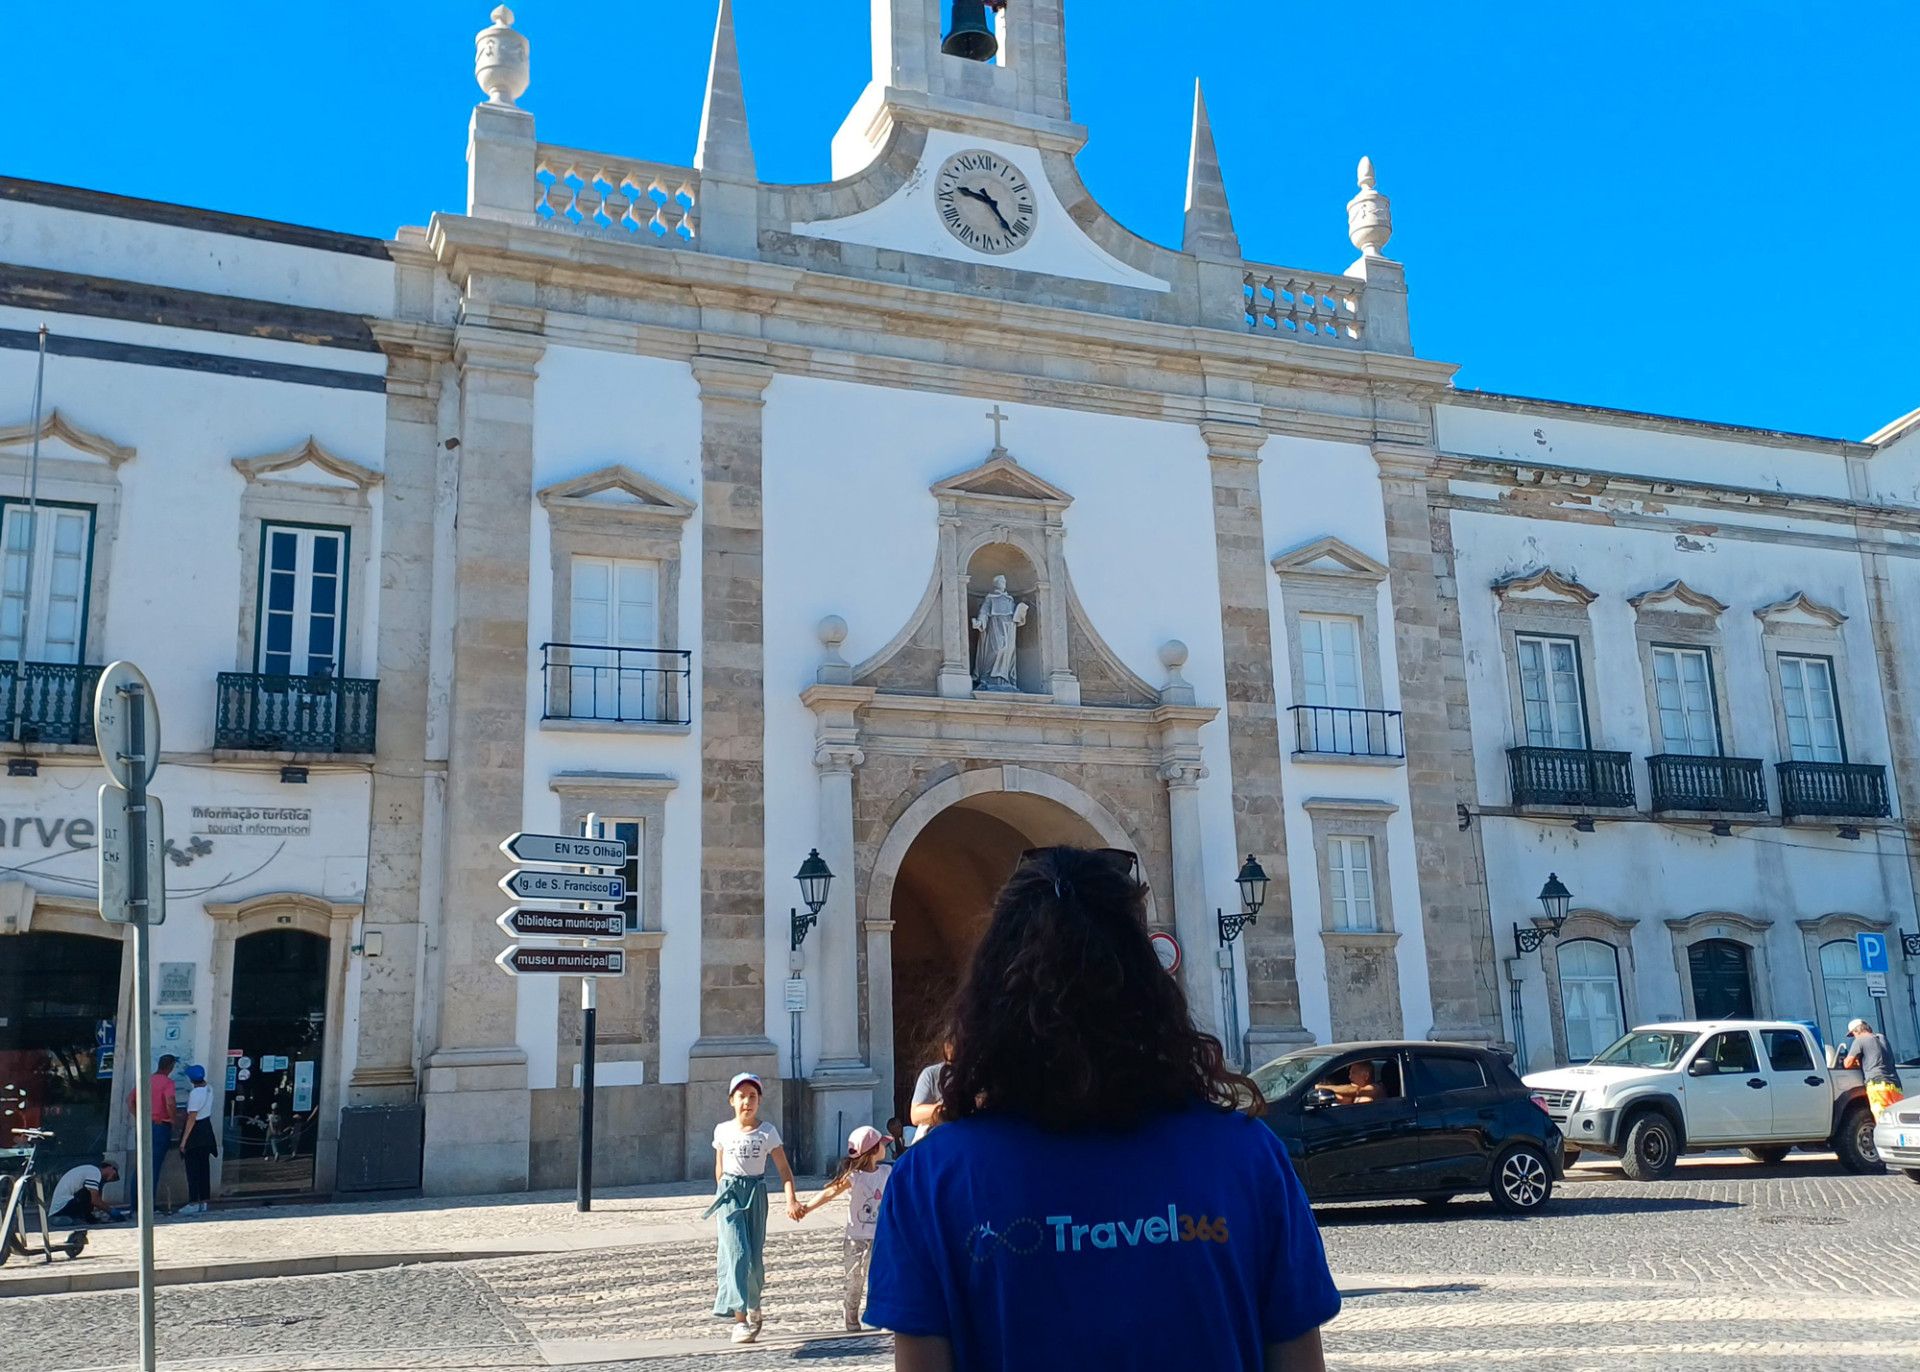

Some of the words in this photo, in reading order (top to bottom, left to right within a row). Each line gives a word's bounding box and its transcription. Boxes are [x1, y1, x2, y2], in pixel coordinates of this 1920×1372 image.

[957, 155, 974, 173] XI
[977, 154, 992, 171] XII
[1000, 165, 1009, 177] I
[1012, 183, 1027, 193] II
[1018, 203, 1033, 214] III
[208, 824, 243, 834] tourist
[246, 823, 308, 835] information
[555, 842, 570, 854] EN
[574, 844, 590, 856] 125
[593, 845, 622, 858] Olhão
[535, 878, 547, 889] de
[551, 879, 561, 890] S.
[564, 880, 608, 893] Francisco
[517, 914, 563, 928] biblioteca
[565, 917, 609, 931] municipal
[1863, 936, 1881, 969] P
[517, 956, 555, 965] museu
[557, 955, 608, 968] municipal
